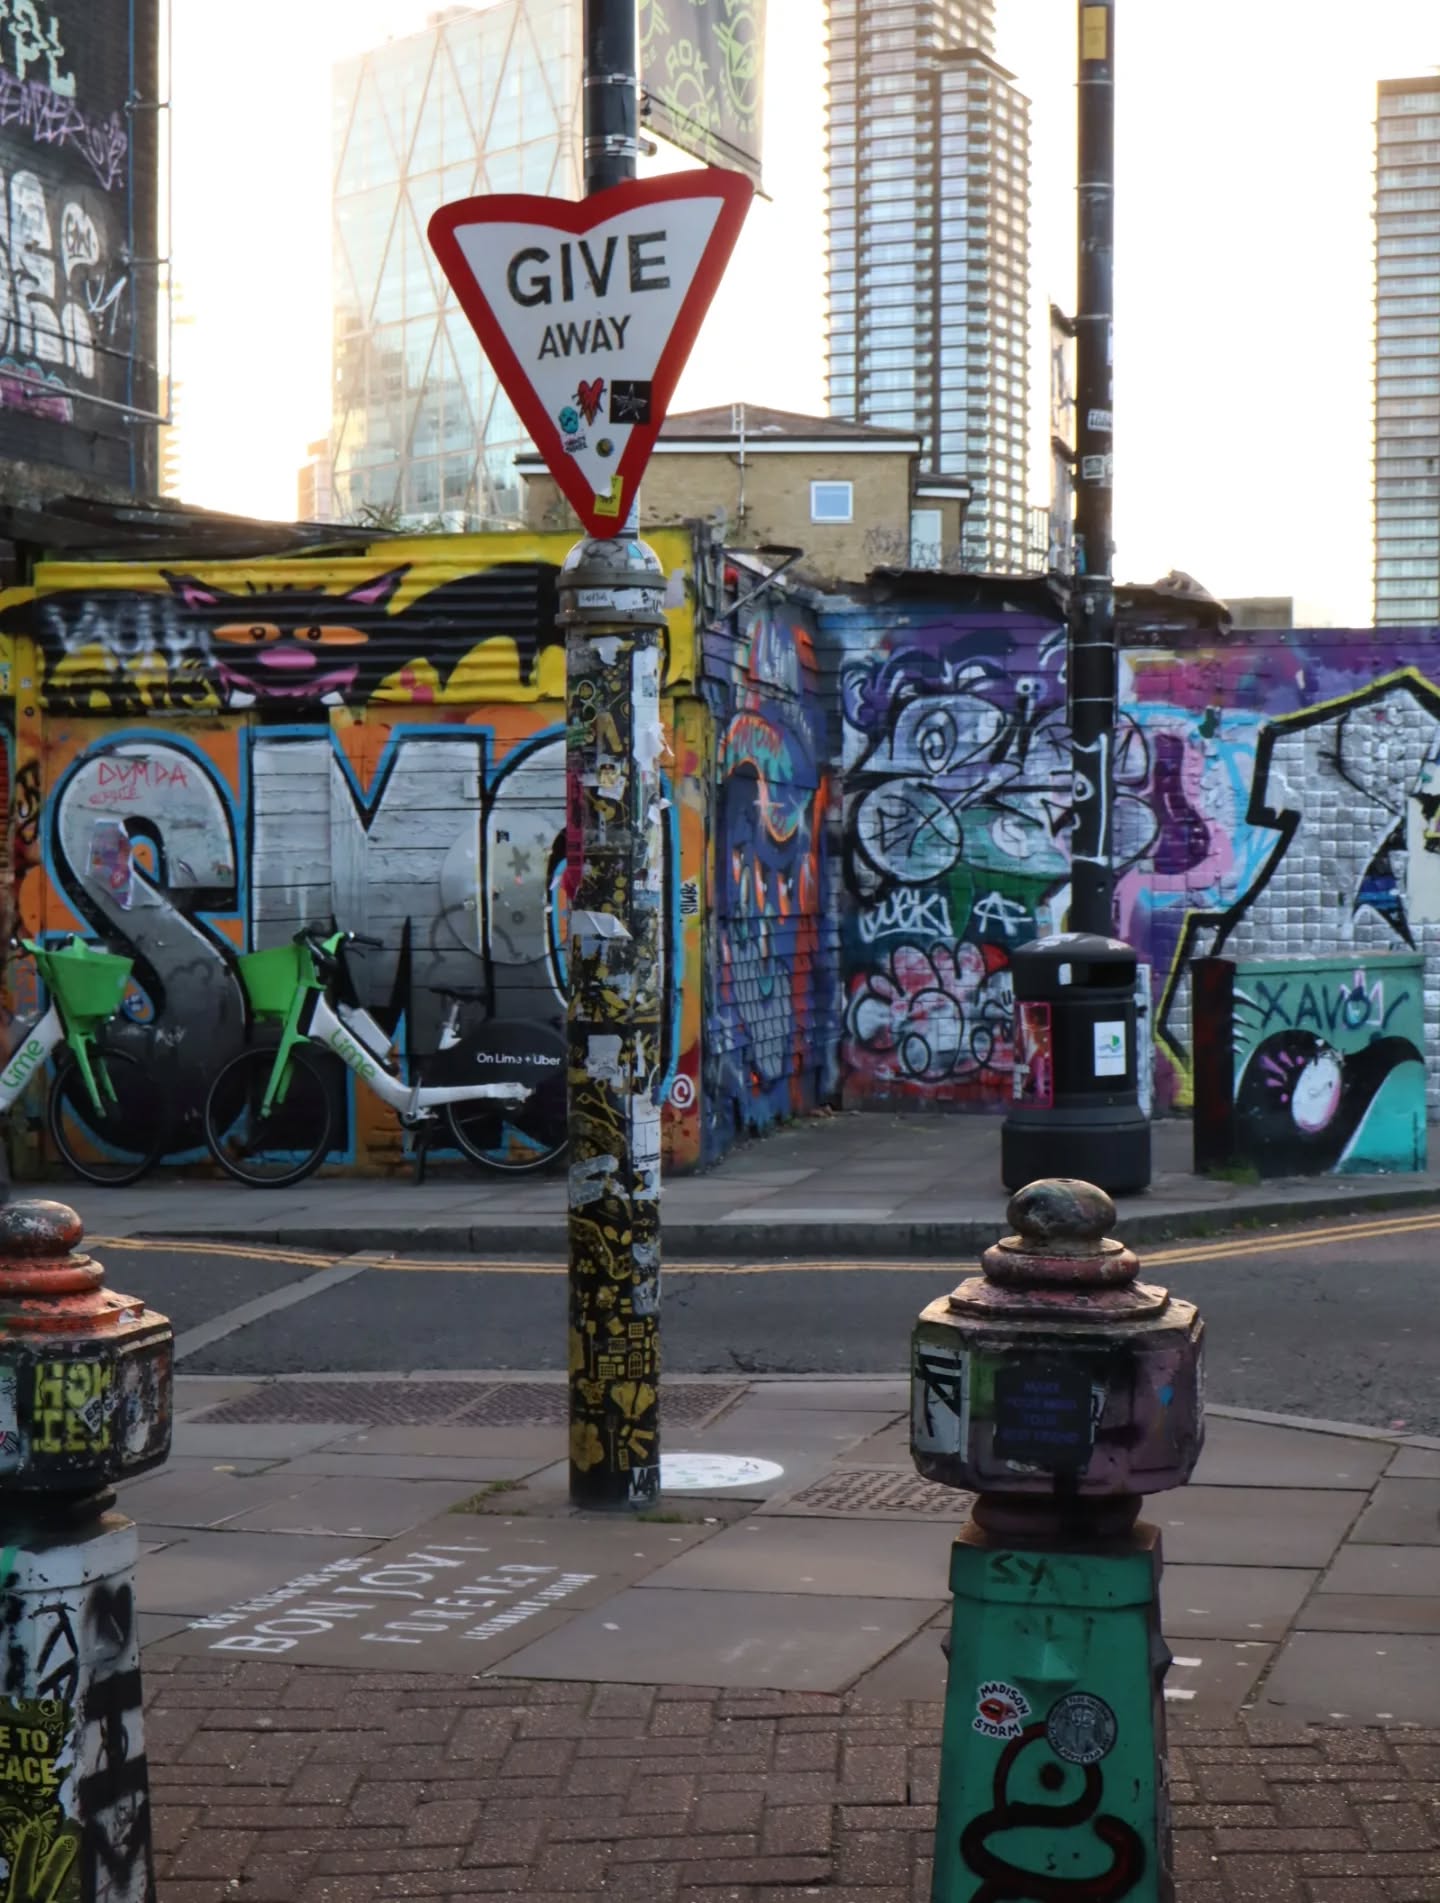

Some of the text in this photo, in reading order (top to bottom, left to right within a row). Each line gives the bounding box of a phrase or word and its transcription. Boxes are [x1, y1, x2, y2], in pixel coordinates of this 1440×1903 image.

[507, 230, 671, 308] GIVE
[537, 314, 632, 360] AWAY
[2, 1039, 44, 1088] Lime
[330, 1028, 377, 1081] Lime
[476, 1052, 494, 1064] On
[533, 1055, 561, 1065] Uber
[208, 1601, 376, 1653] BON
[333, 1545, 490, 1599] JOVI
[360, 1564, 558, 1644] FOREVER
[980, 1683, 1029, 1714] MADISON
[16, 1728, 49, 1753] TO
[974, 1718, 1020, 1736] STORM
